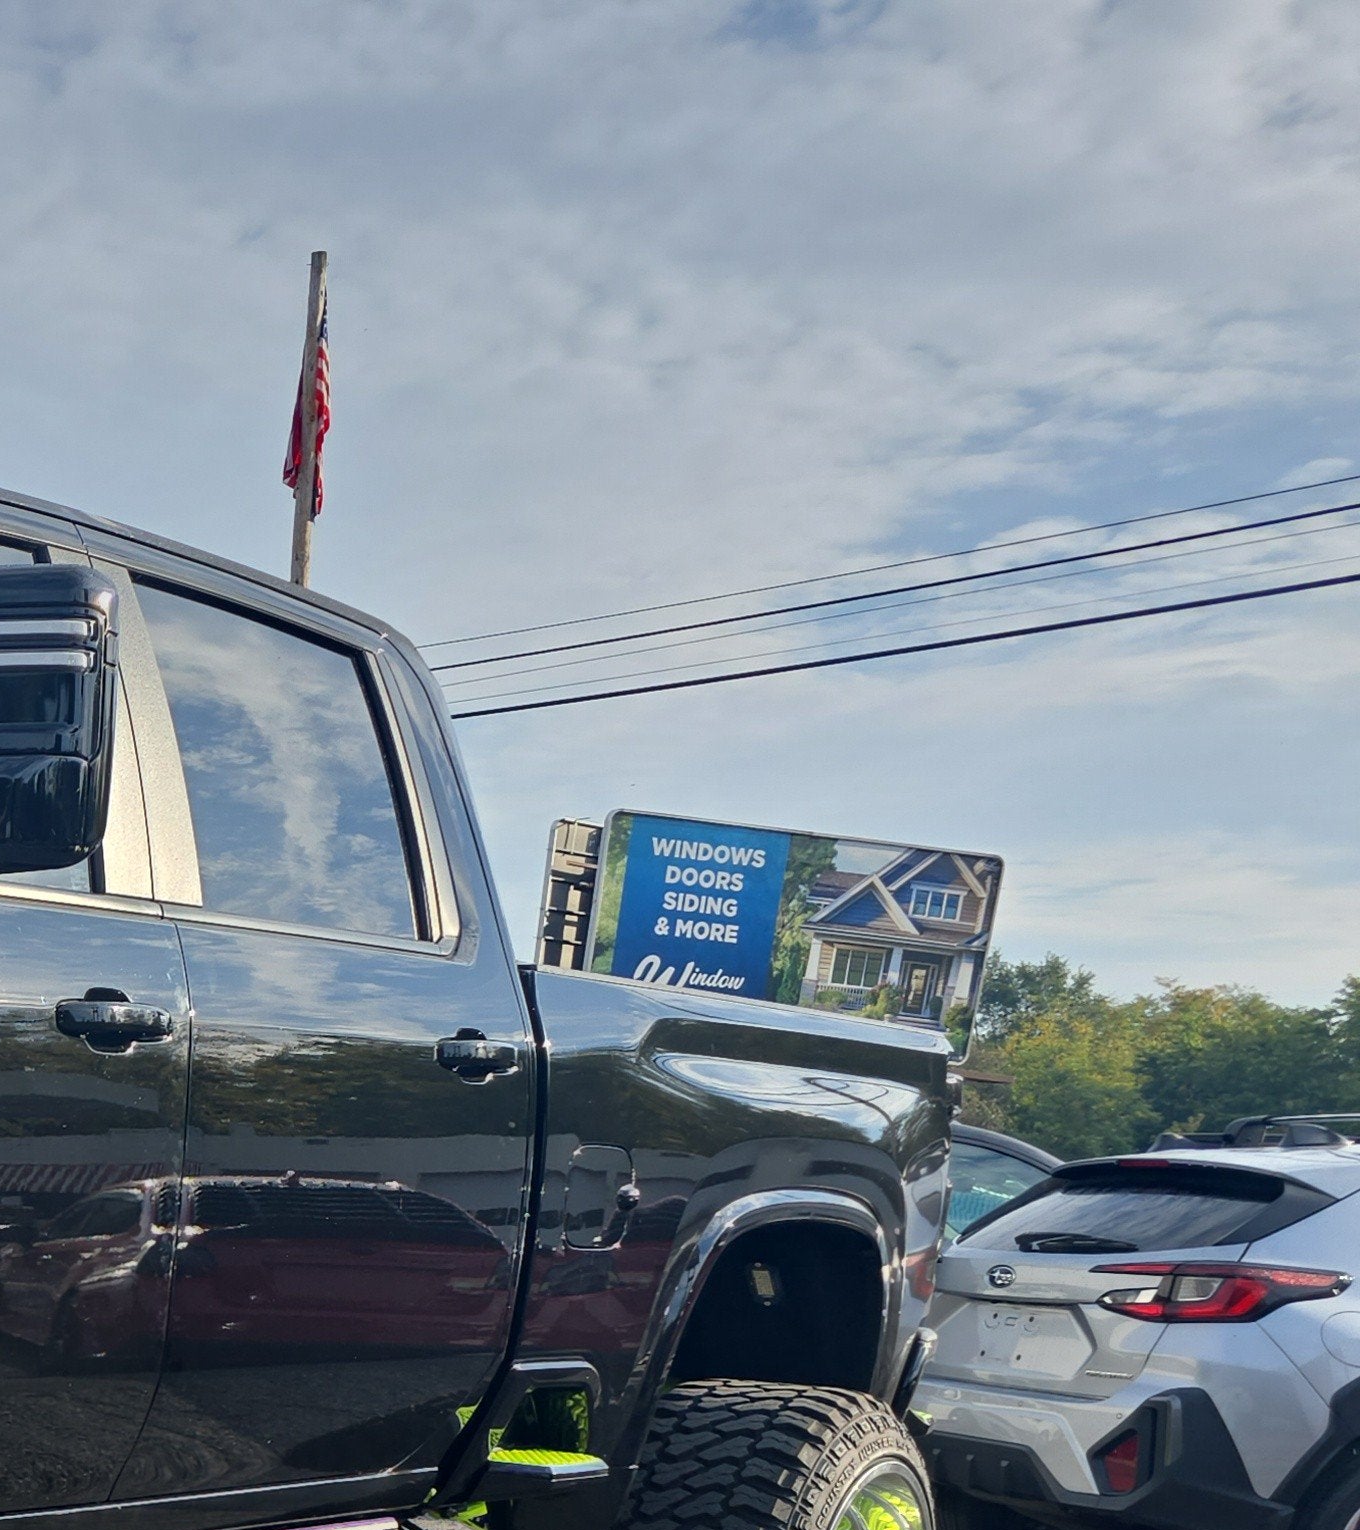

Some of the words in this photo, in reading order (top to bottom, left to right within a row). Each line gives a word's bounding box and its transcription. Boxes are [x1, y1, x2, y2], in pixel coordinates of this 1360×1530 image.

[651, 836, 767, 868] WINDOWS
[664, 865, 744, 892] DOORS
[662, 891, 738, 917] SIDING
[654, 916, 670, 936] &
[674, 919, 739, 944] MORE
